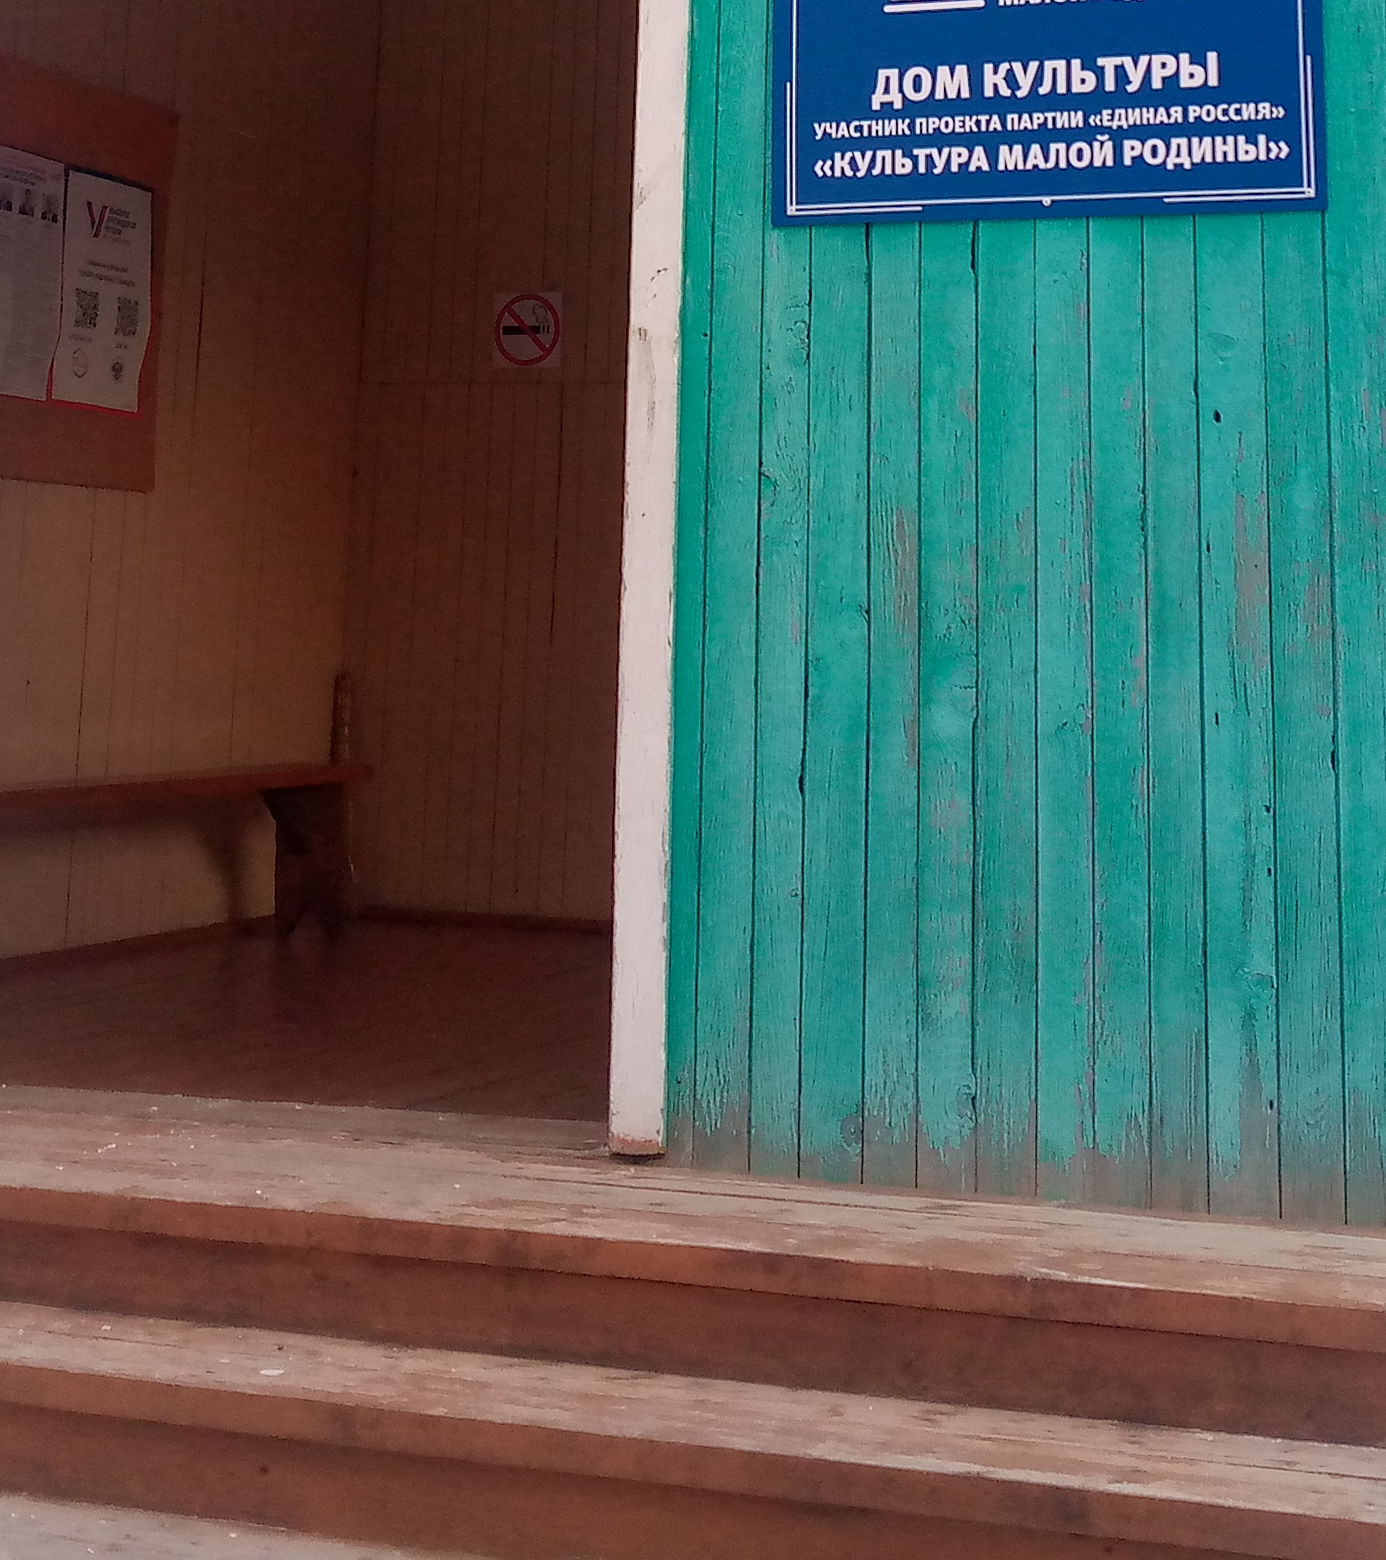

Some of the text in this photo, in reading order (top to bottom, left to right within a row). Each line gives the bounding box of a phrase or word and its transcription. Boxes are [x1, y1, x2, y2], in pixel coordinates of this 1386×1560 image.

[871, 51, 1219, 111] ДОМ КУЛЬТУРЫ
[814, 102, 1285, 140] УЧАСТНИК ПРОЕКТА ПАРТИИ «ЕДИНАЯ РОССИЯ»
[814, 133, 1290, 179] «КУЛЬТУРА МАЛОЙ РОДИНЫ»
